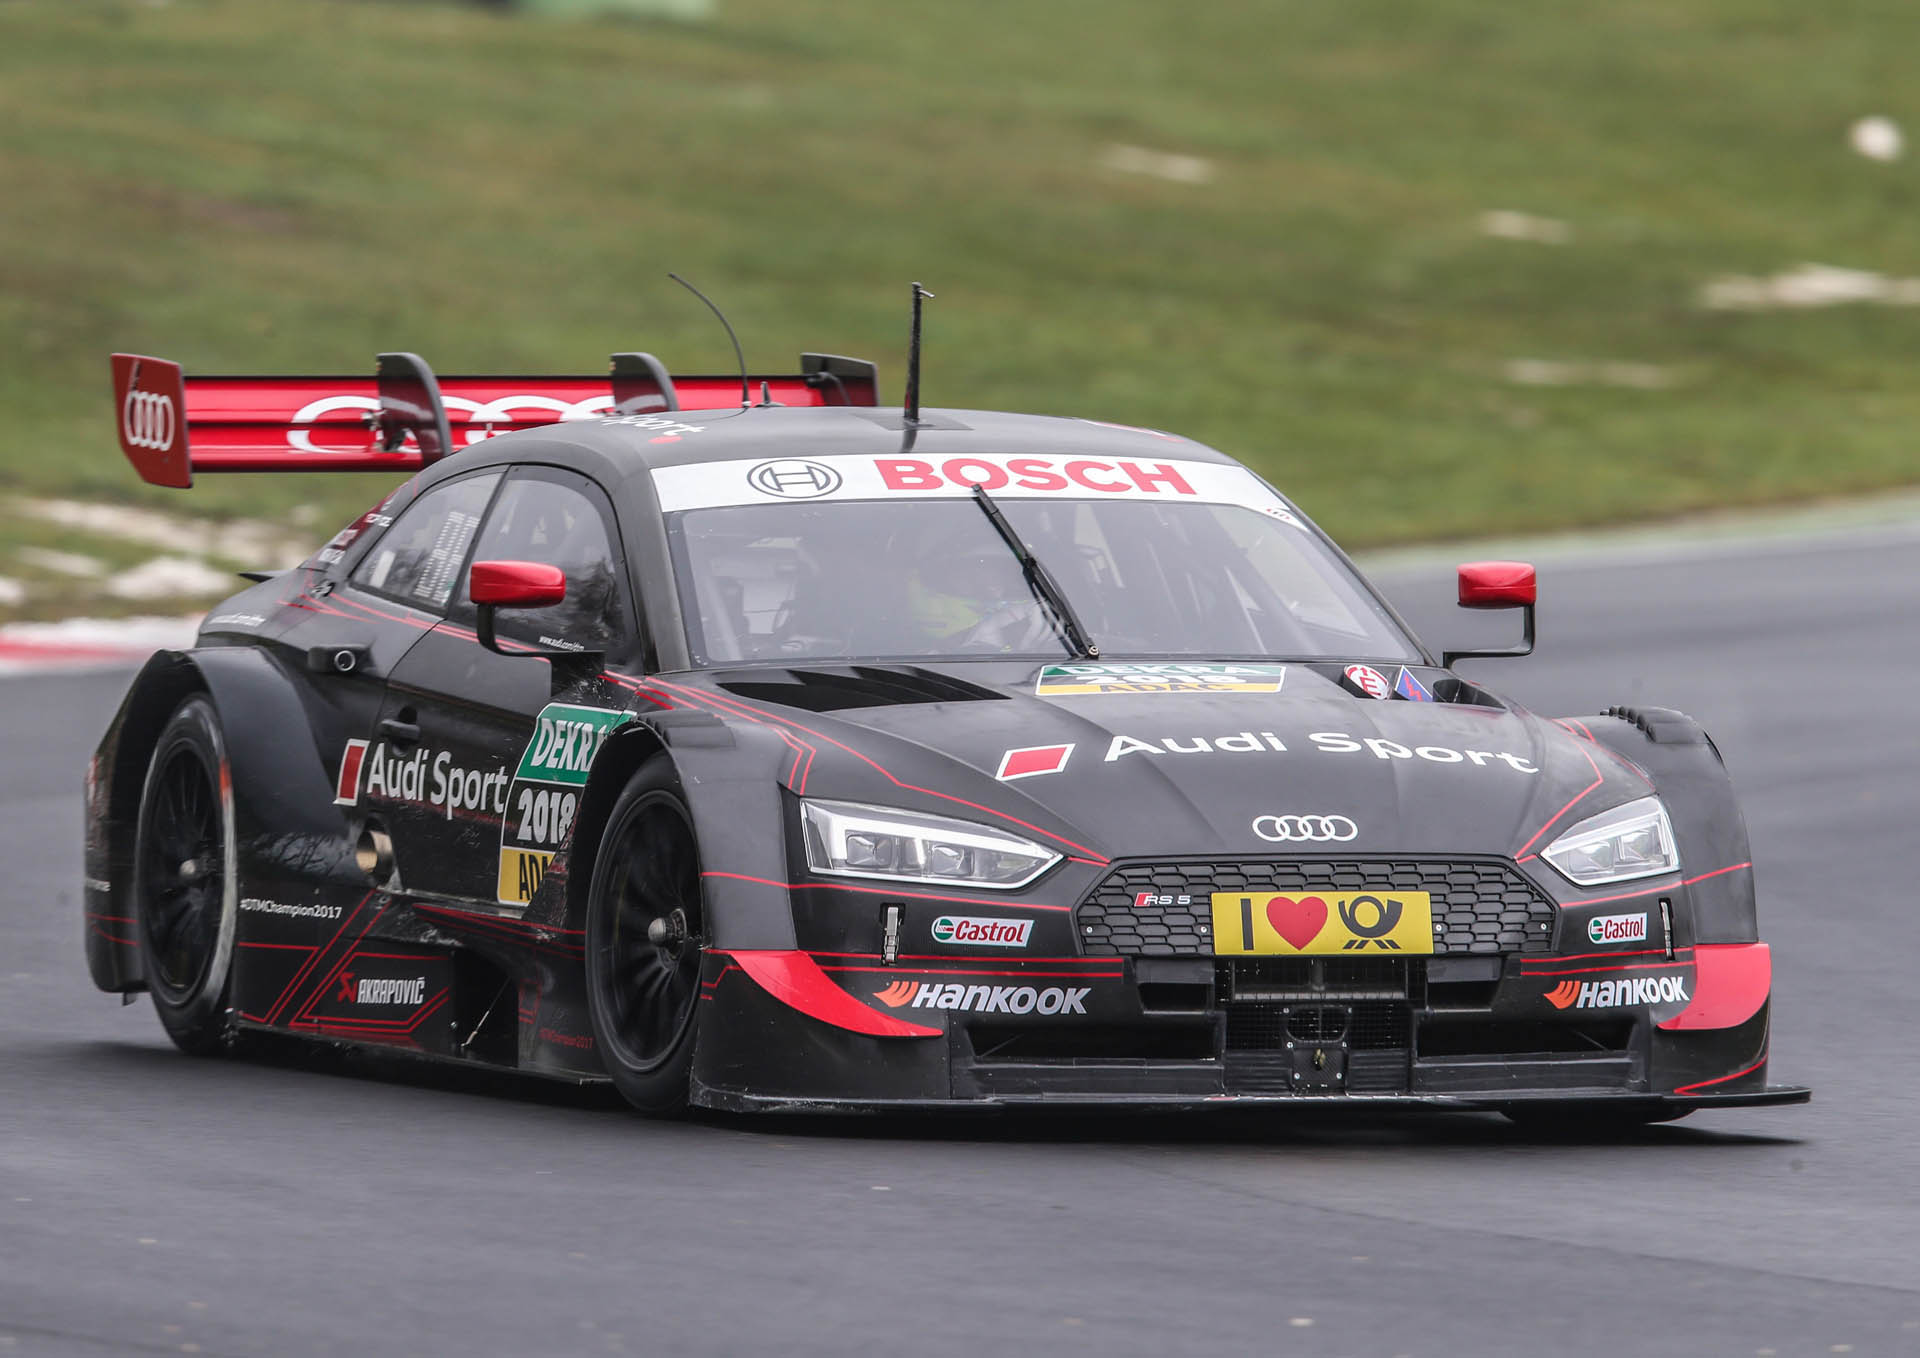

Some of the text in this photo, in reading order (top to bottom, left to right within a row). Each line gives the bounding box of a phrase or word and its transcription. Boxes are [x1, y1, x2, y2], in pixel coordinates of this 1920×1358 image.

[873, 458, 1198, 495] BOSCH
[1103, 732, 1540, 774] Audi Sport
[366, 742, 508, 820] Audi Sport
[517, 788, 576, 844] 2018
[239, 898, 343, 919] #DTMChampion2017
[1143, 894, 1191, 905] RS 5
[955, 920, 1025, 943] Castrol
[1240, 898, 1254, 950] I
[1604, 917, 1644, 940] Castrol
